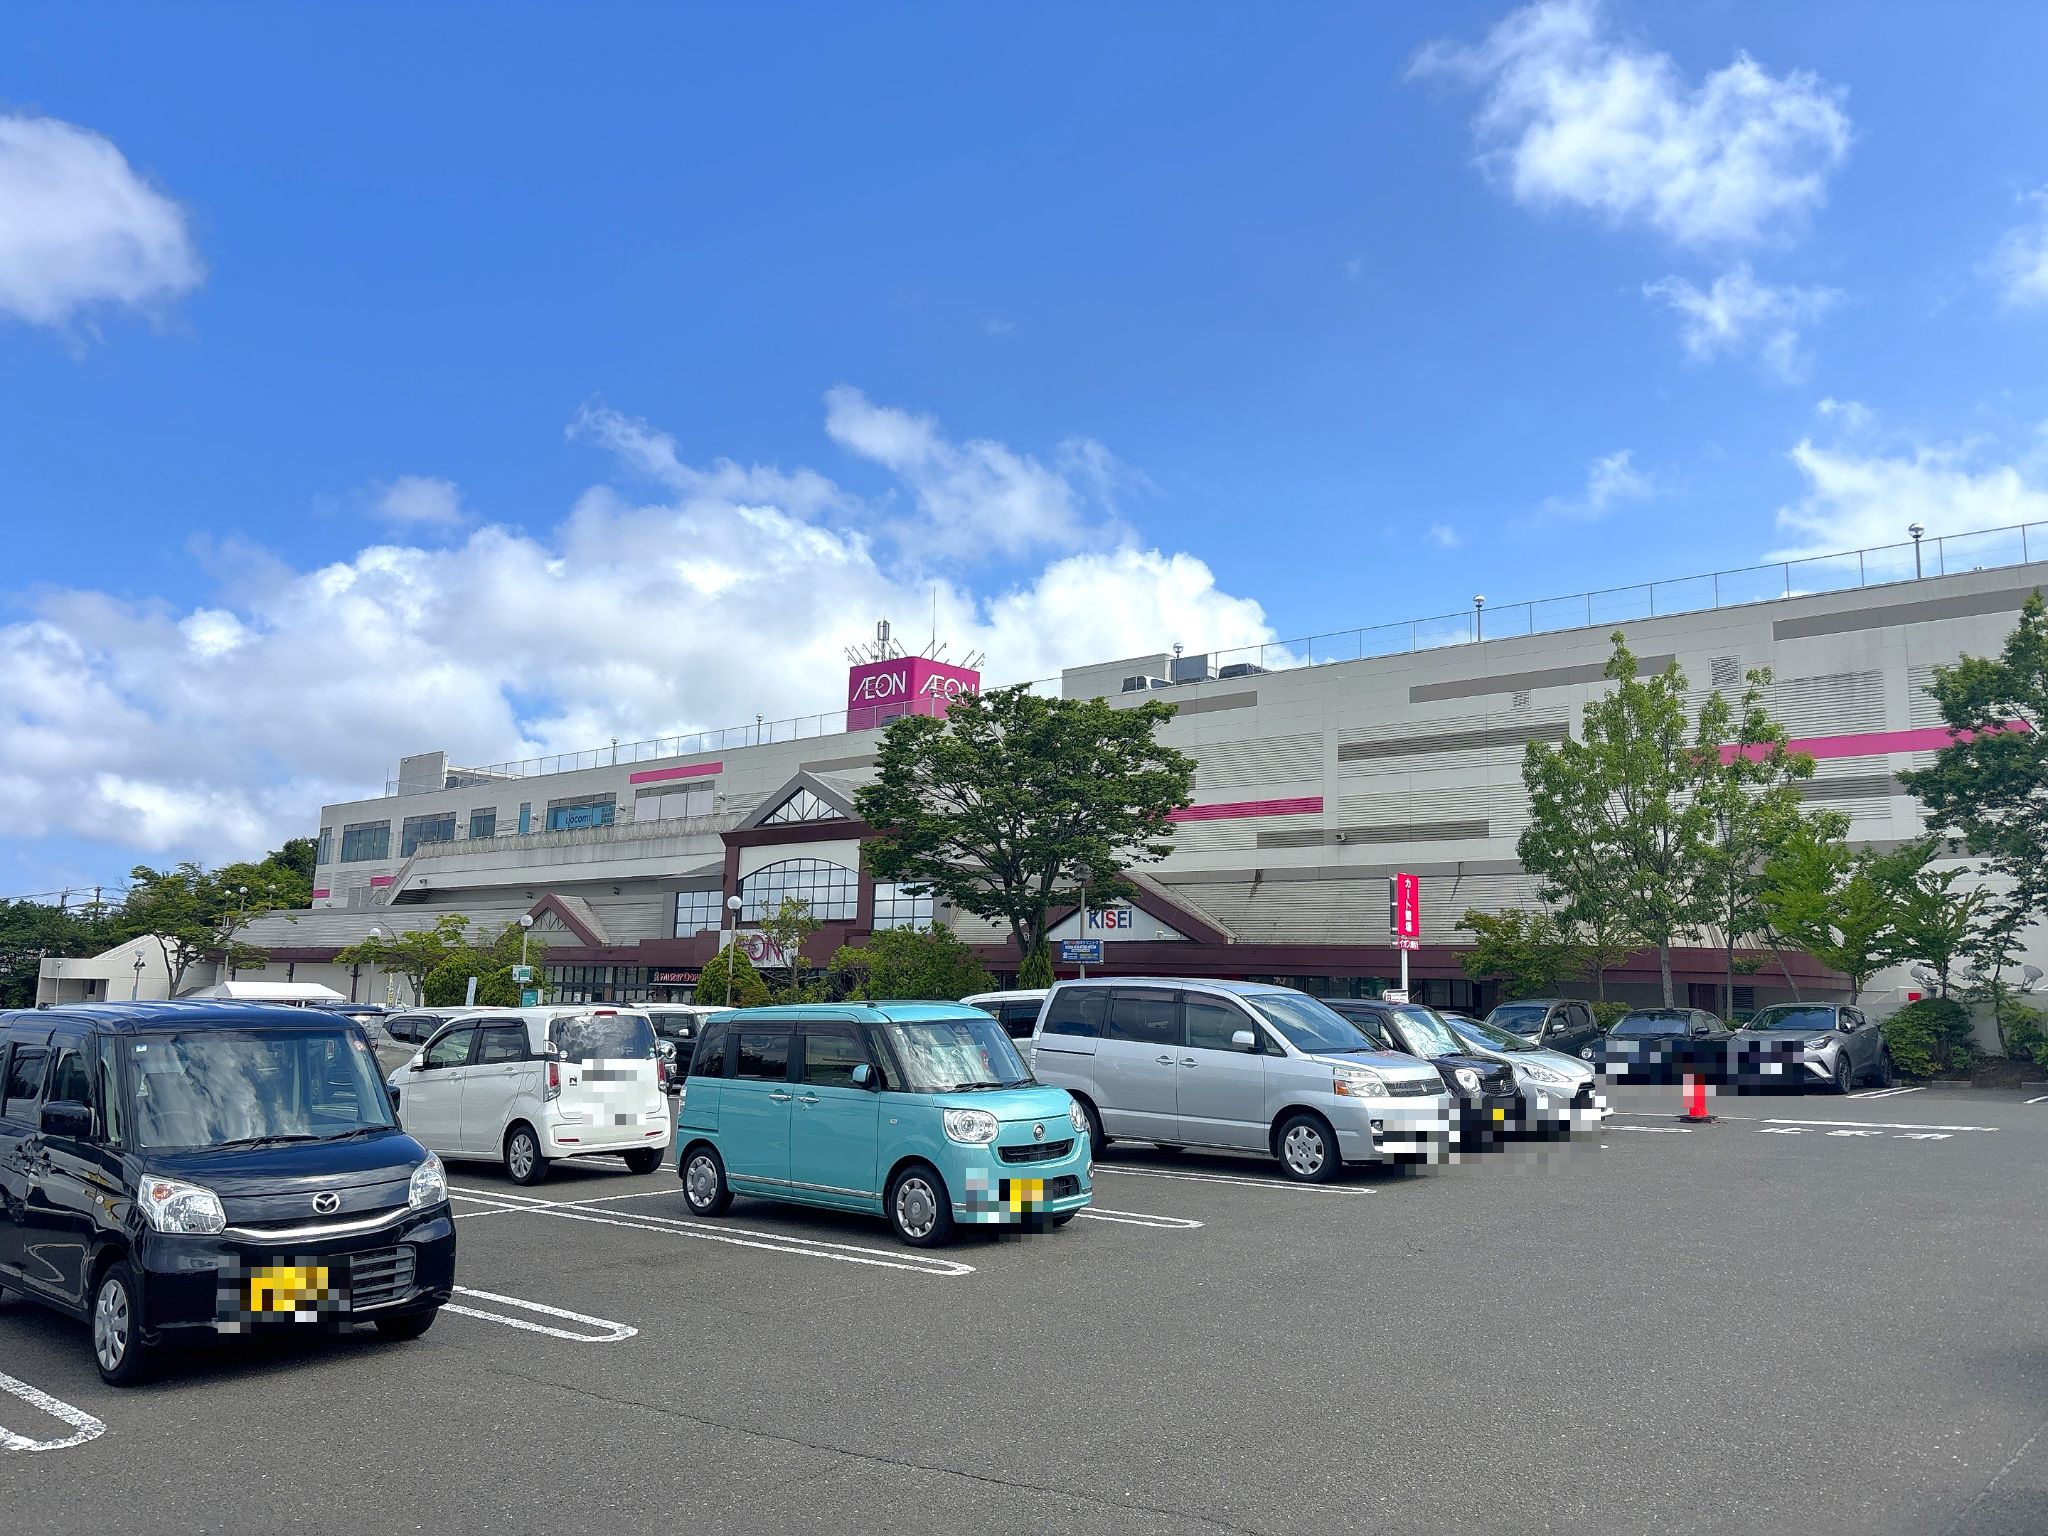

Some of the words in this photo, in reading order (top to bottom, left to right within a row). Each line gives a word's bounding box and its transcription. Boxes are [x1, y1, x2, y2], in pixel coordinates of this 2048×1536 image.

[1088, 910, 1133, 929] KISEI
[1404, 878, 1412, 932] カート
